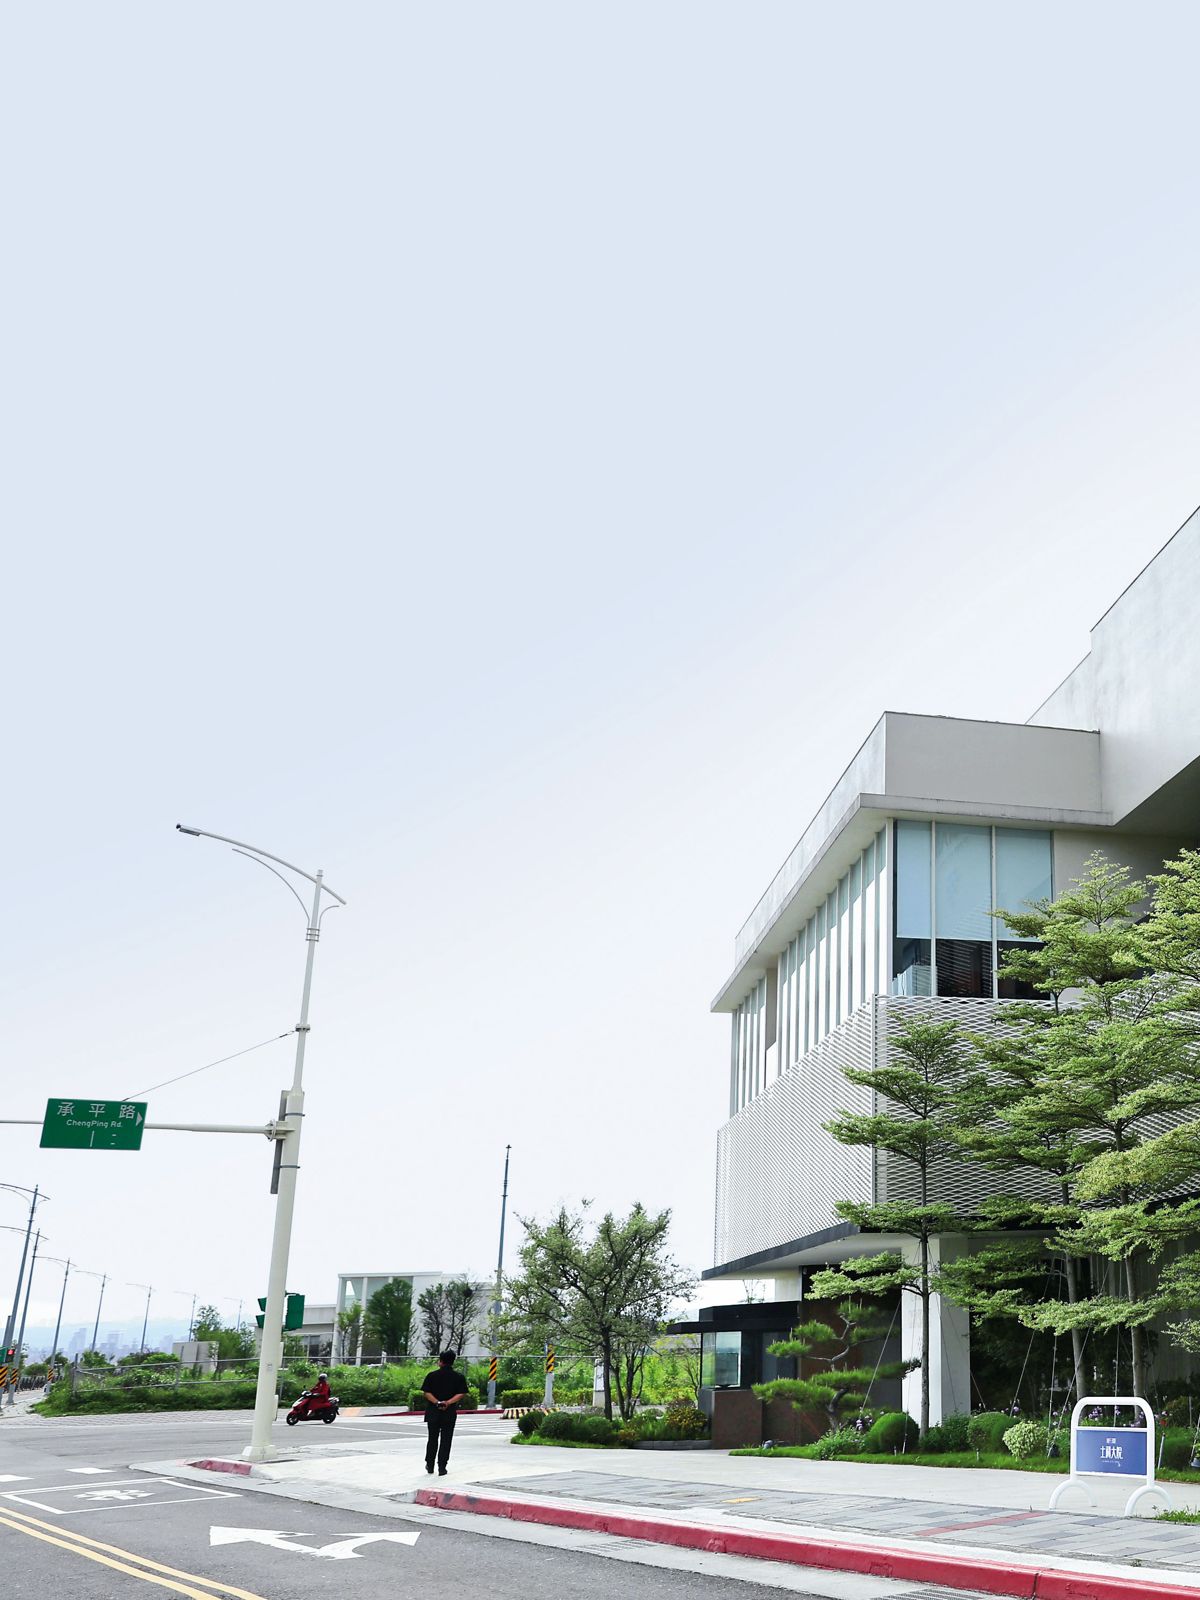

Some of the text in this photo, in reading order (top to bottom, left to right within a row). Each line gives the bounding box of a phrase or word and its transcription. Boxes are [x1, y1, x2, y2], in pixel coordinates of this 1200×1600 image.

[57, 1102, 136, 1119] 承平路
[66, 1119, 108, 1129] ChengPing
